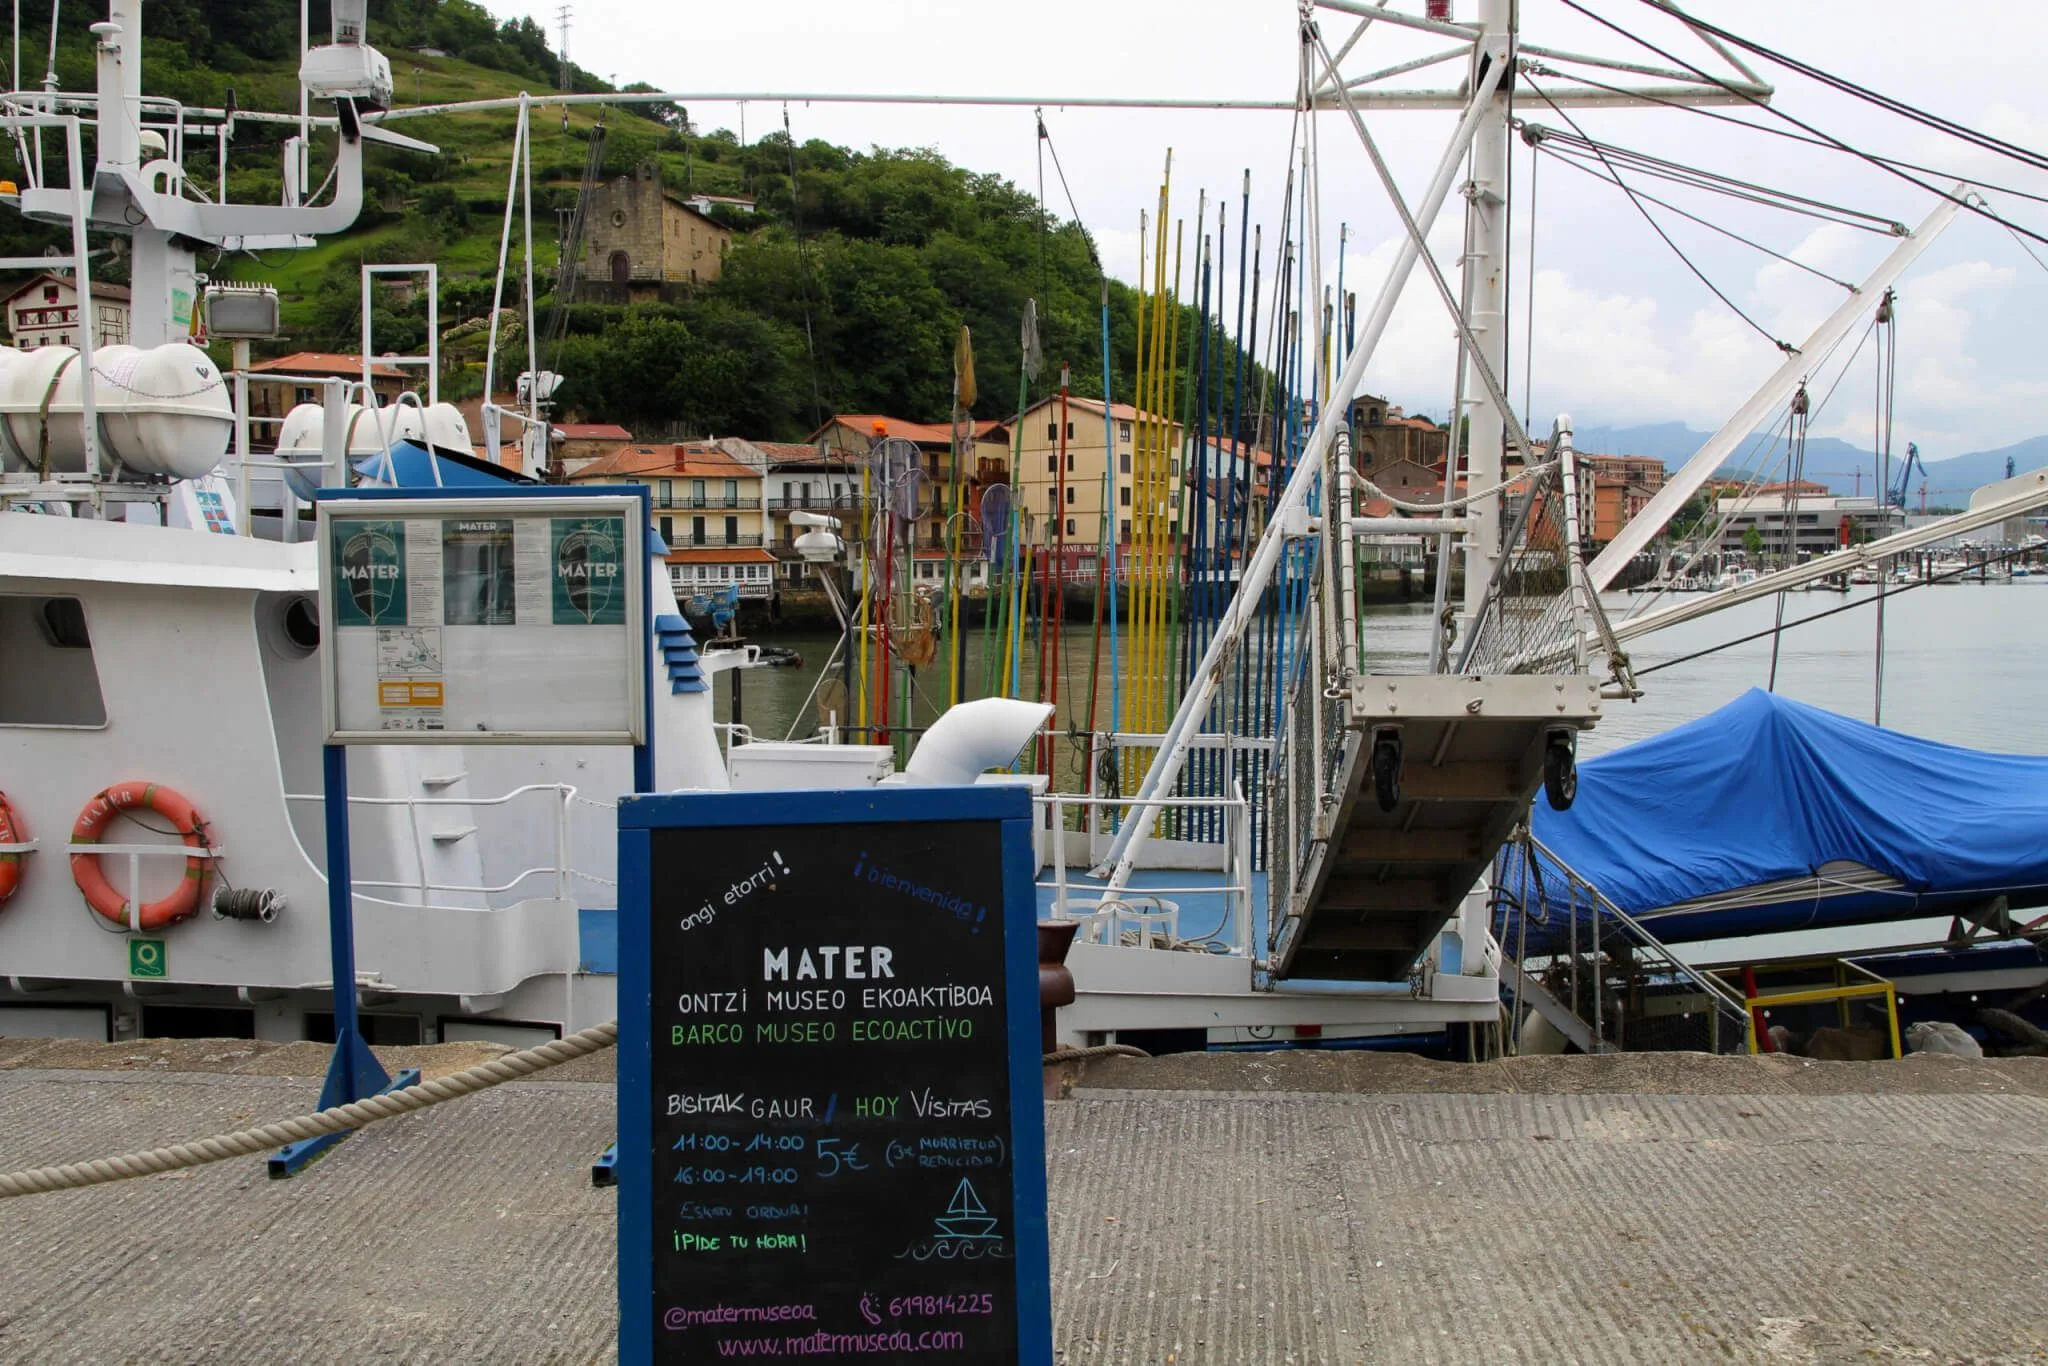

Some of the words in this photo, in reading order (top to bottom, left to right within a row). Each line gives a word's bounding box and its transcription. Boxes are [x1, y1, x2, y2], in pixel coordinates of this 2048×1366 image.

[459, 521, 497, 531] MATER
[341, 564, 400, 579] MATER
[558, 562, 618, 577] MATER
[81, 790, 132, 829] MATER
[680, 899, 717, 931] ongi
[723, 850, 791, 905] etorri!
[763, 945, 895, 981] MATER
[678, 988, 747, 1013] ONTZI
[767, 990, 846, 1012] MUSEO
[863, 983, 993, 1009] EKOAKTIBOA
[671, 1023, 743, 1046] BARCO
[756, 1022, 836, 1043] MUSEO
[852, 1016, 973, 1041] ECOACTIVO
[665, 1092, 745, 1115] BISITAK
[751, 1098, 814, 1119] GAUR
[855, 1096, 899, 1118] HOY
[816, 1138, 869, 1178] 5€
[673, 1229, 721, 1252] ¡PIDE
[730, 1235, 748, 1248] TU
[756, 1233, 807, 1253] HORA!
[663, 1303, 818, 1331] @matermuseoa
[889, 1293, 993, 1317] 619814225
[717, 1327, 963, 1357] www.matermuseoa.com
